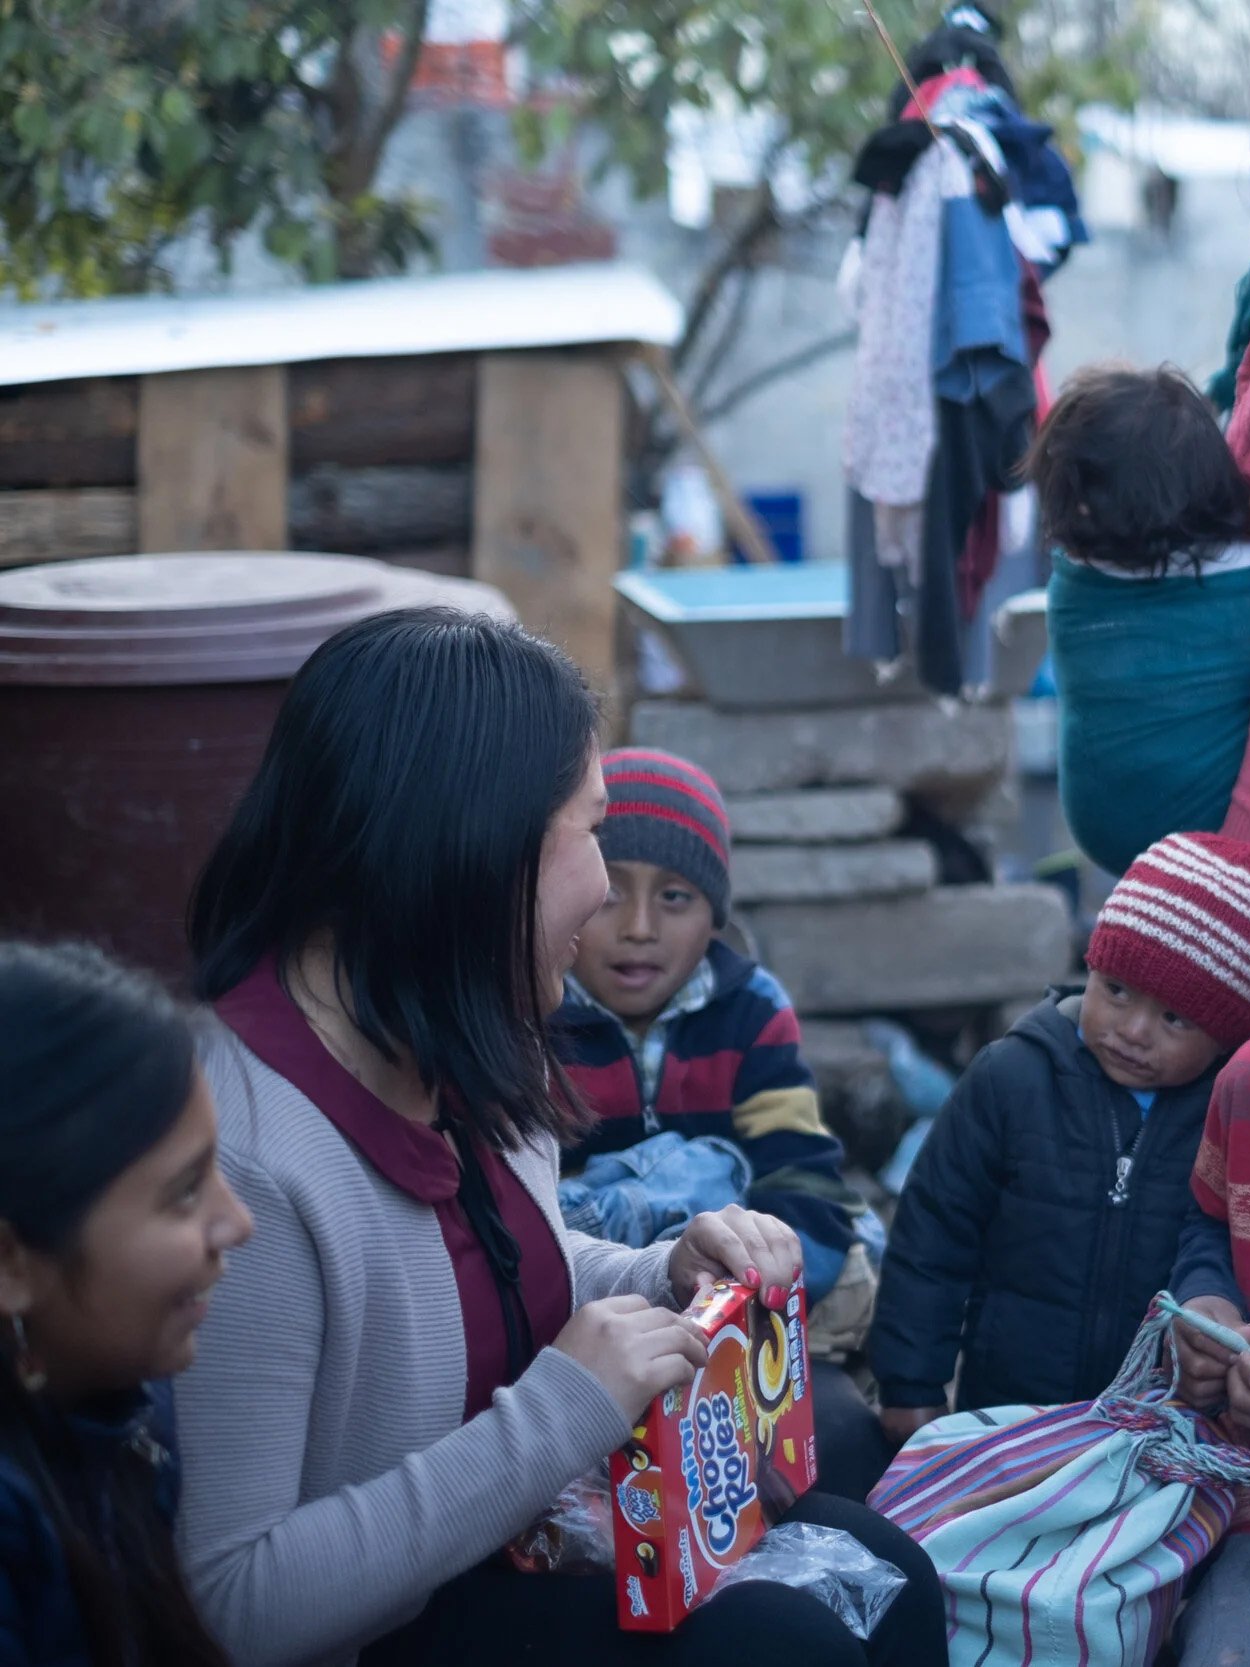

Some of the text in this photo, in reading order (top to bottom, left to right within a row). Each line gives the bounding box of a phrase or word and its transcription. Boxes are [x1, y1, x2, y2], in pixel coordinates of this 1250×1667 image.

[680, 1418, 701, 1511] Mini
[696, 1398, 736, 1553] Choco
[712, 1392, 755, 1517] Roles
[679, 1528, 695, 1608] Marinela
